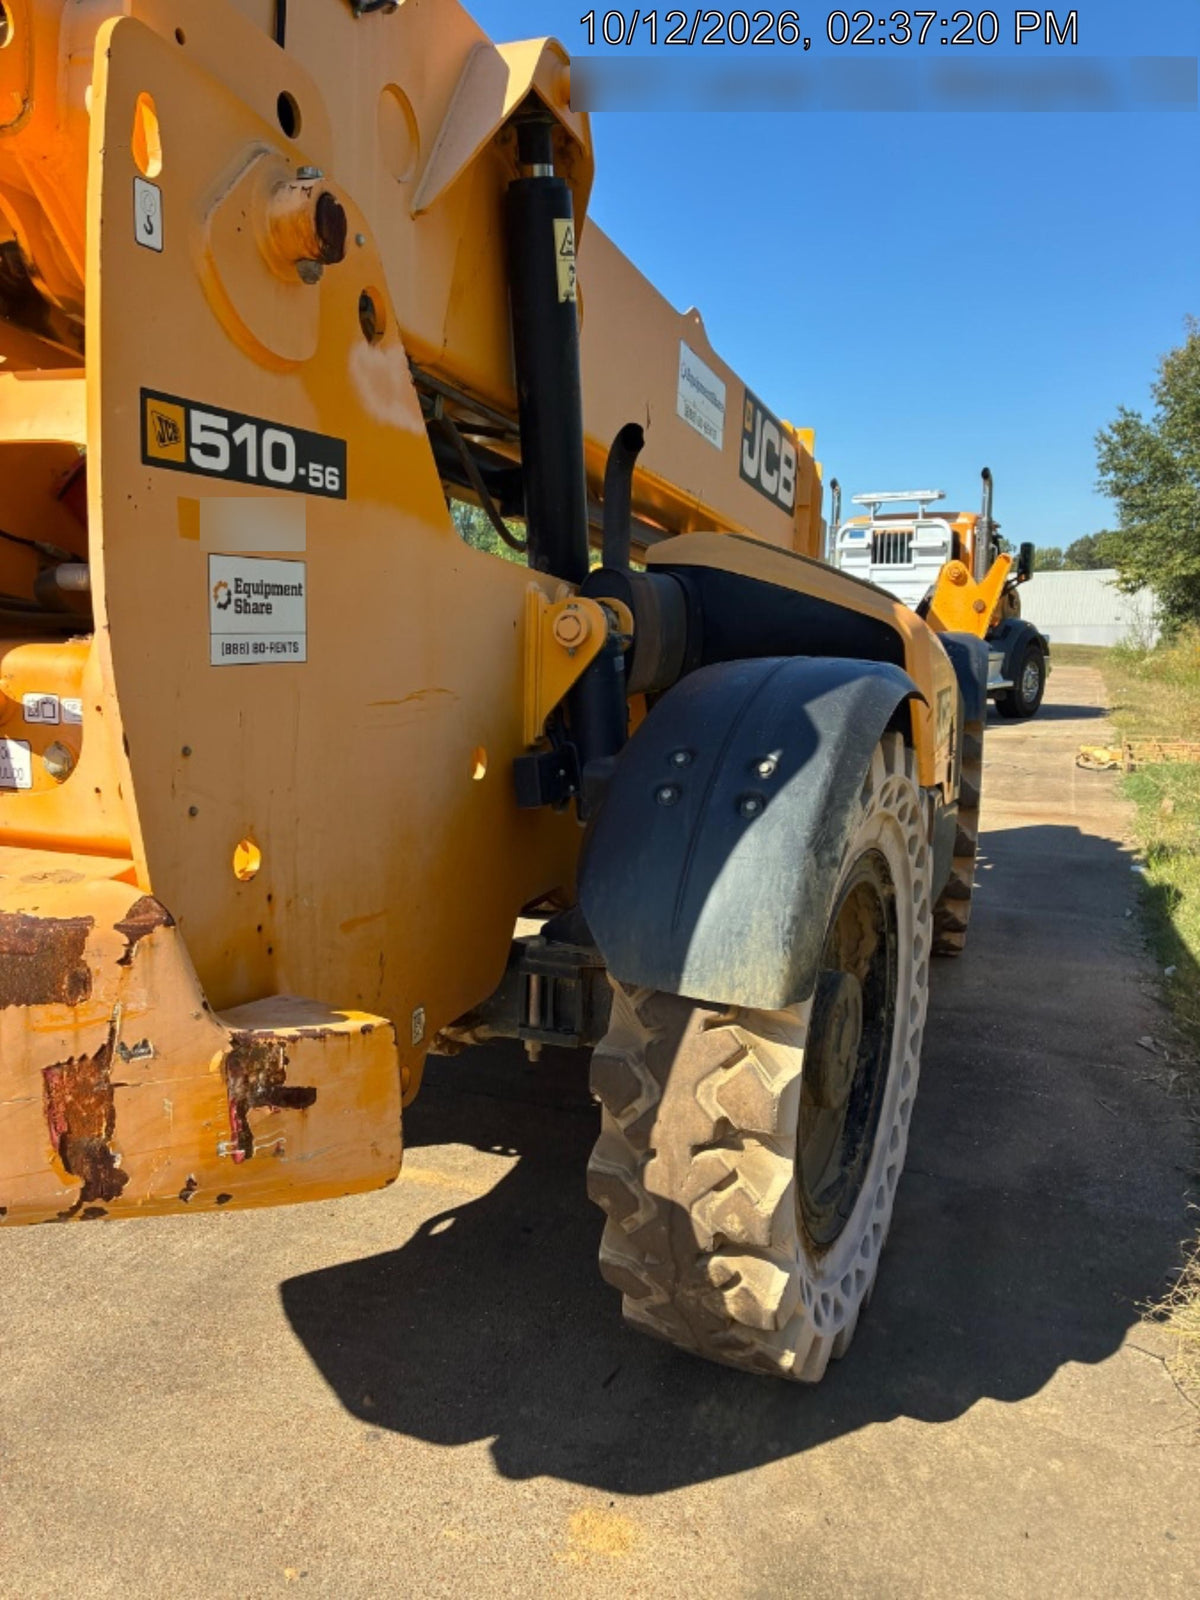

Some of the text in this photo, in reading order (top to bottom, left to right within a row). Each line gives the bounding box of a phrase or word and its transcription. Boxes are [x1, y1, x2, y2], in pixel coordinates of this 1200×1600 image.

[743, 409, 797, 508] JCB
[234, 577, 303, 599] Equipment
[234, 598, 273, 615] Share
